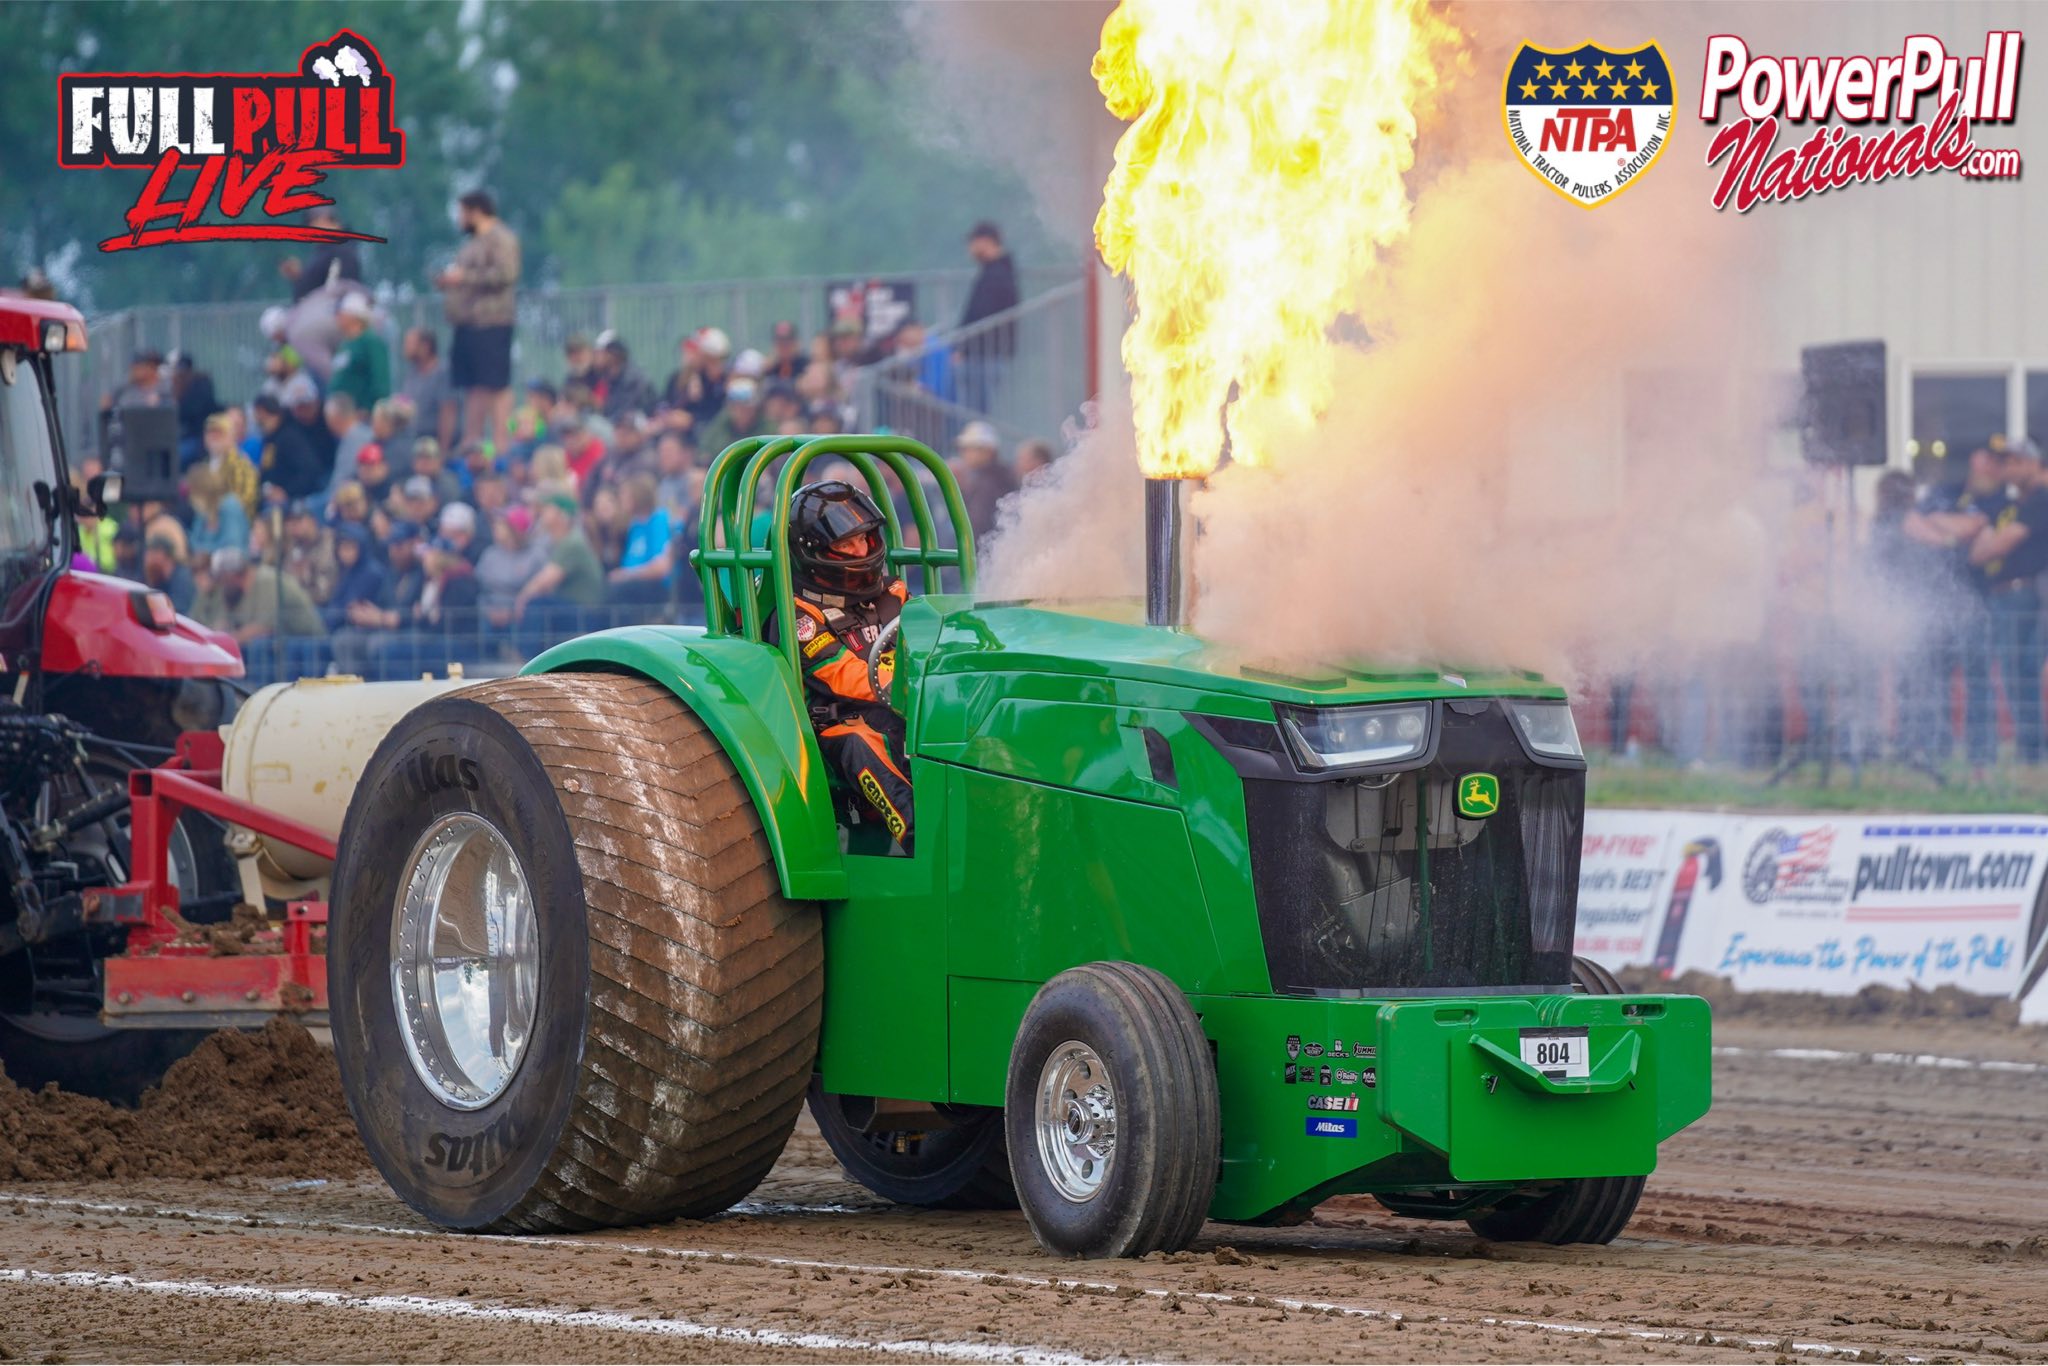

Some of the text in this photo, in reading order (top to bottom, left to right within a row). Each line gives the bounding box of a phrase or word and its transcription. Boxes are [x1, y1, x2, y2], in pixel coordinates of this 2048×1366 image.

[1851, 843, 2035, 904] pulltown.com
[1537, 1042, 1570, 1065] 804
[1307, 1095, 1345, 1111] CASE
[1315, 1121, 1346, 1133] Mitas
